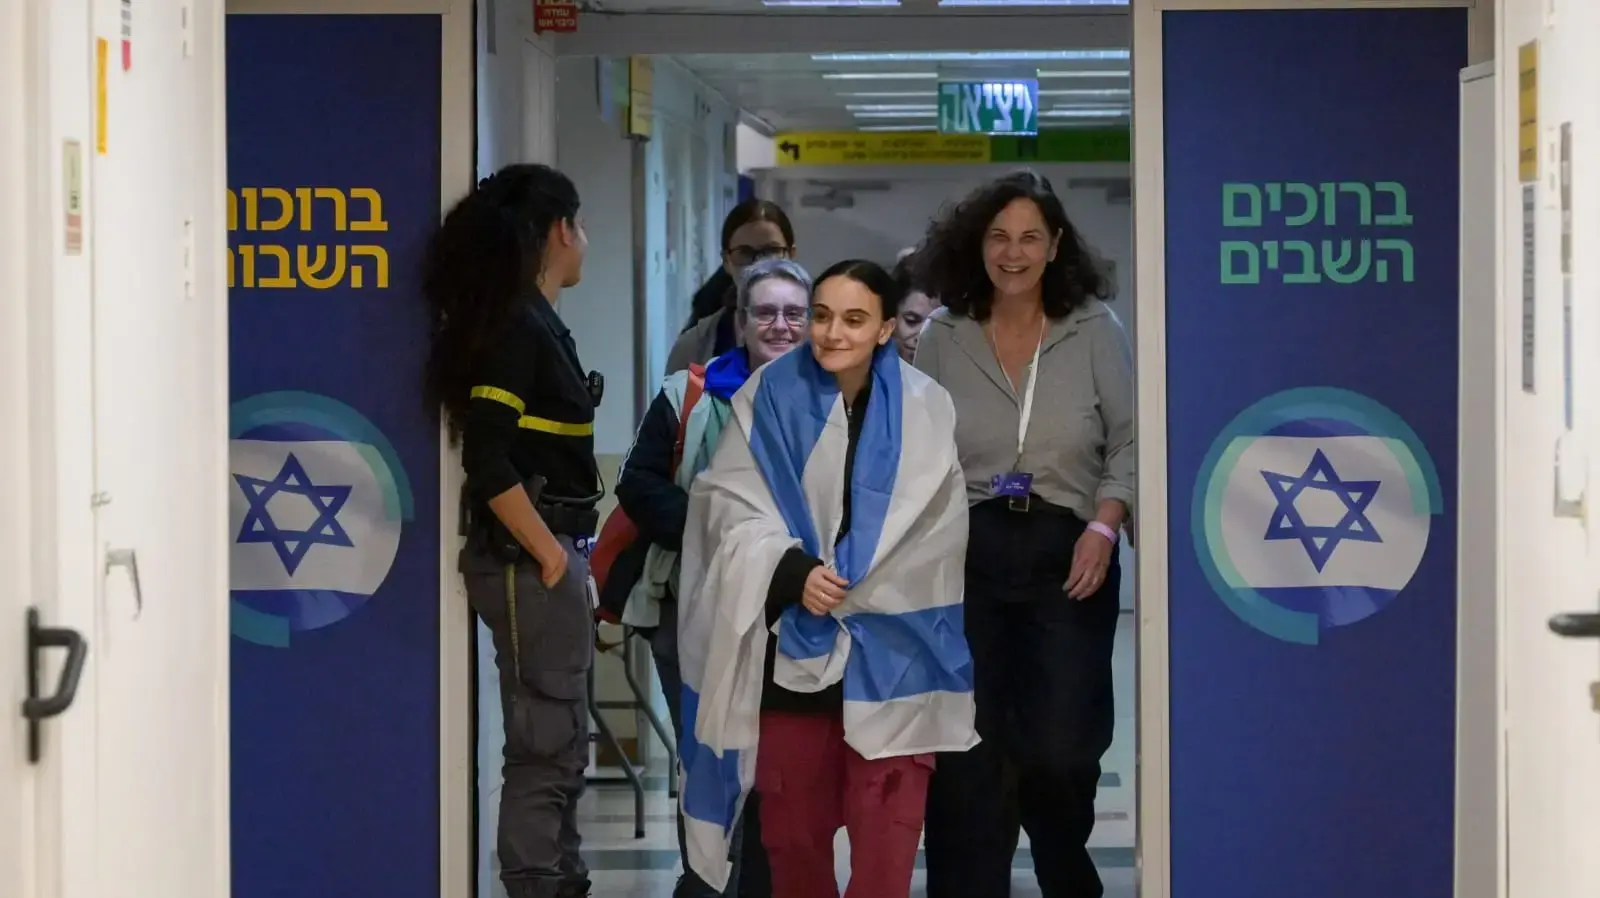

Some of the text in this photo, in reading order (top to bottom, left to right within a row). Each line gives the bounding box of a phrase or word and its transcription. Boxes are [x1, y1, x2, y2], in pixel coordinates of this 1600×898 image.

[941, 82, 1025, 132] יציאה
[1222, 181, 1414, 227] ברוכים
[227, 244, 389, 289] השבו
[1220, 238, 1415, 284] השבים
